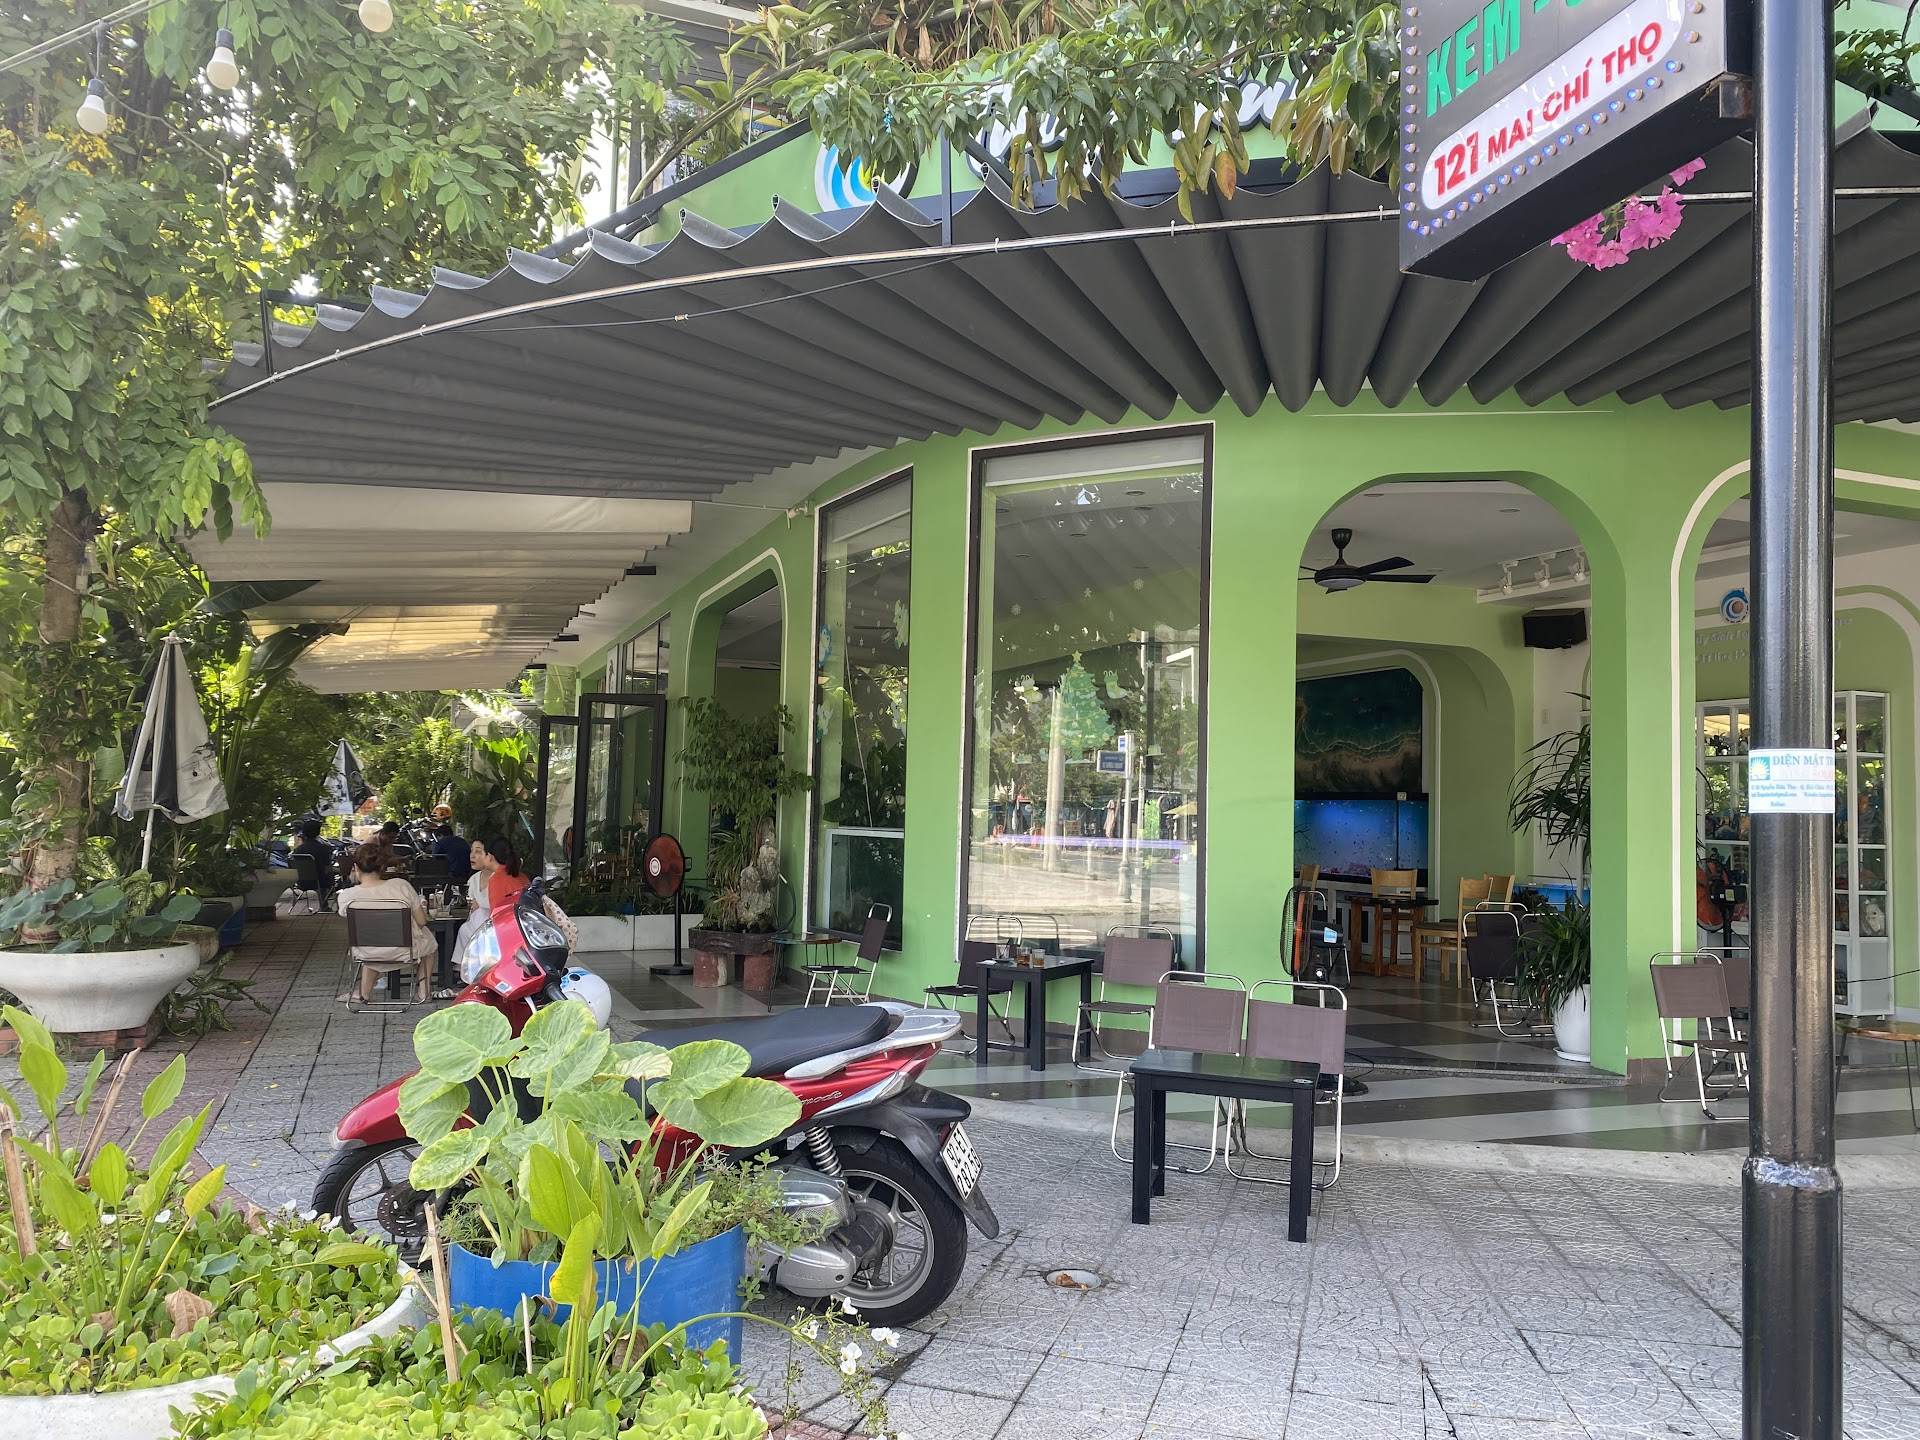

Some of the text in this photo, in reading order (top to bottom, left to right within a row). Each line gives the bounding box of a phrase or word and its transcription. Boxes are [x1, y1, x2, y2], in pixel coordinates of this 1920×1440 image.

[1427, 0, 1520, 118] KEM
[1434, 22, 1663, 197] 121 MAI CHÍ THỌ
[1772, 754, 1801, 767] ĐIỆN
[1803, 753, 1825, 767] MẶT
